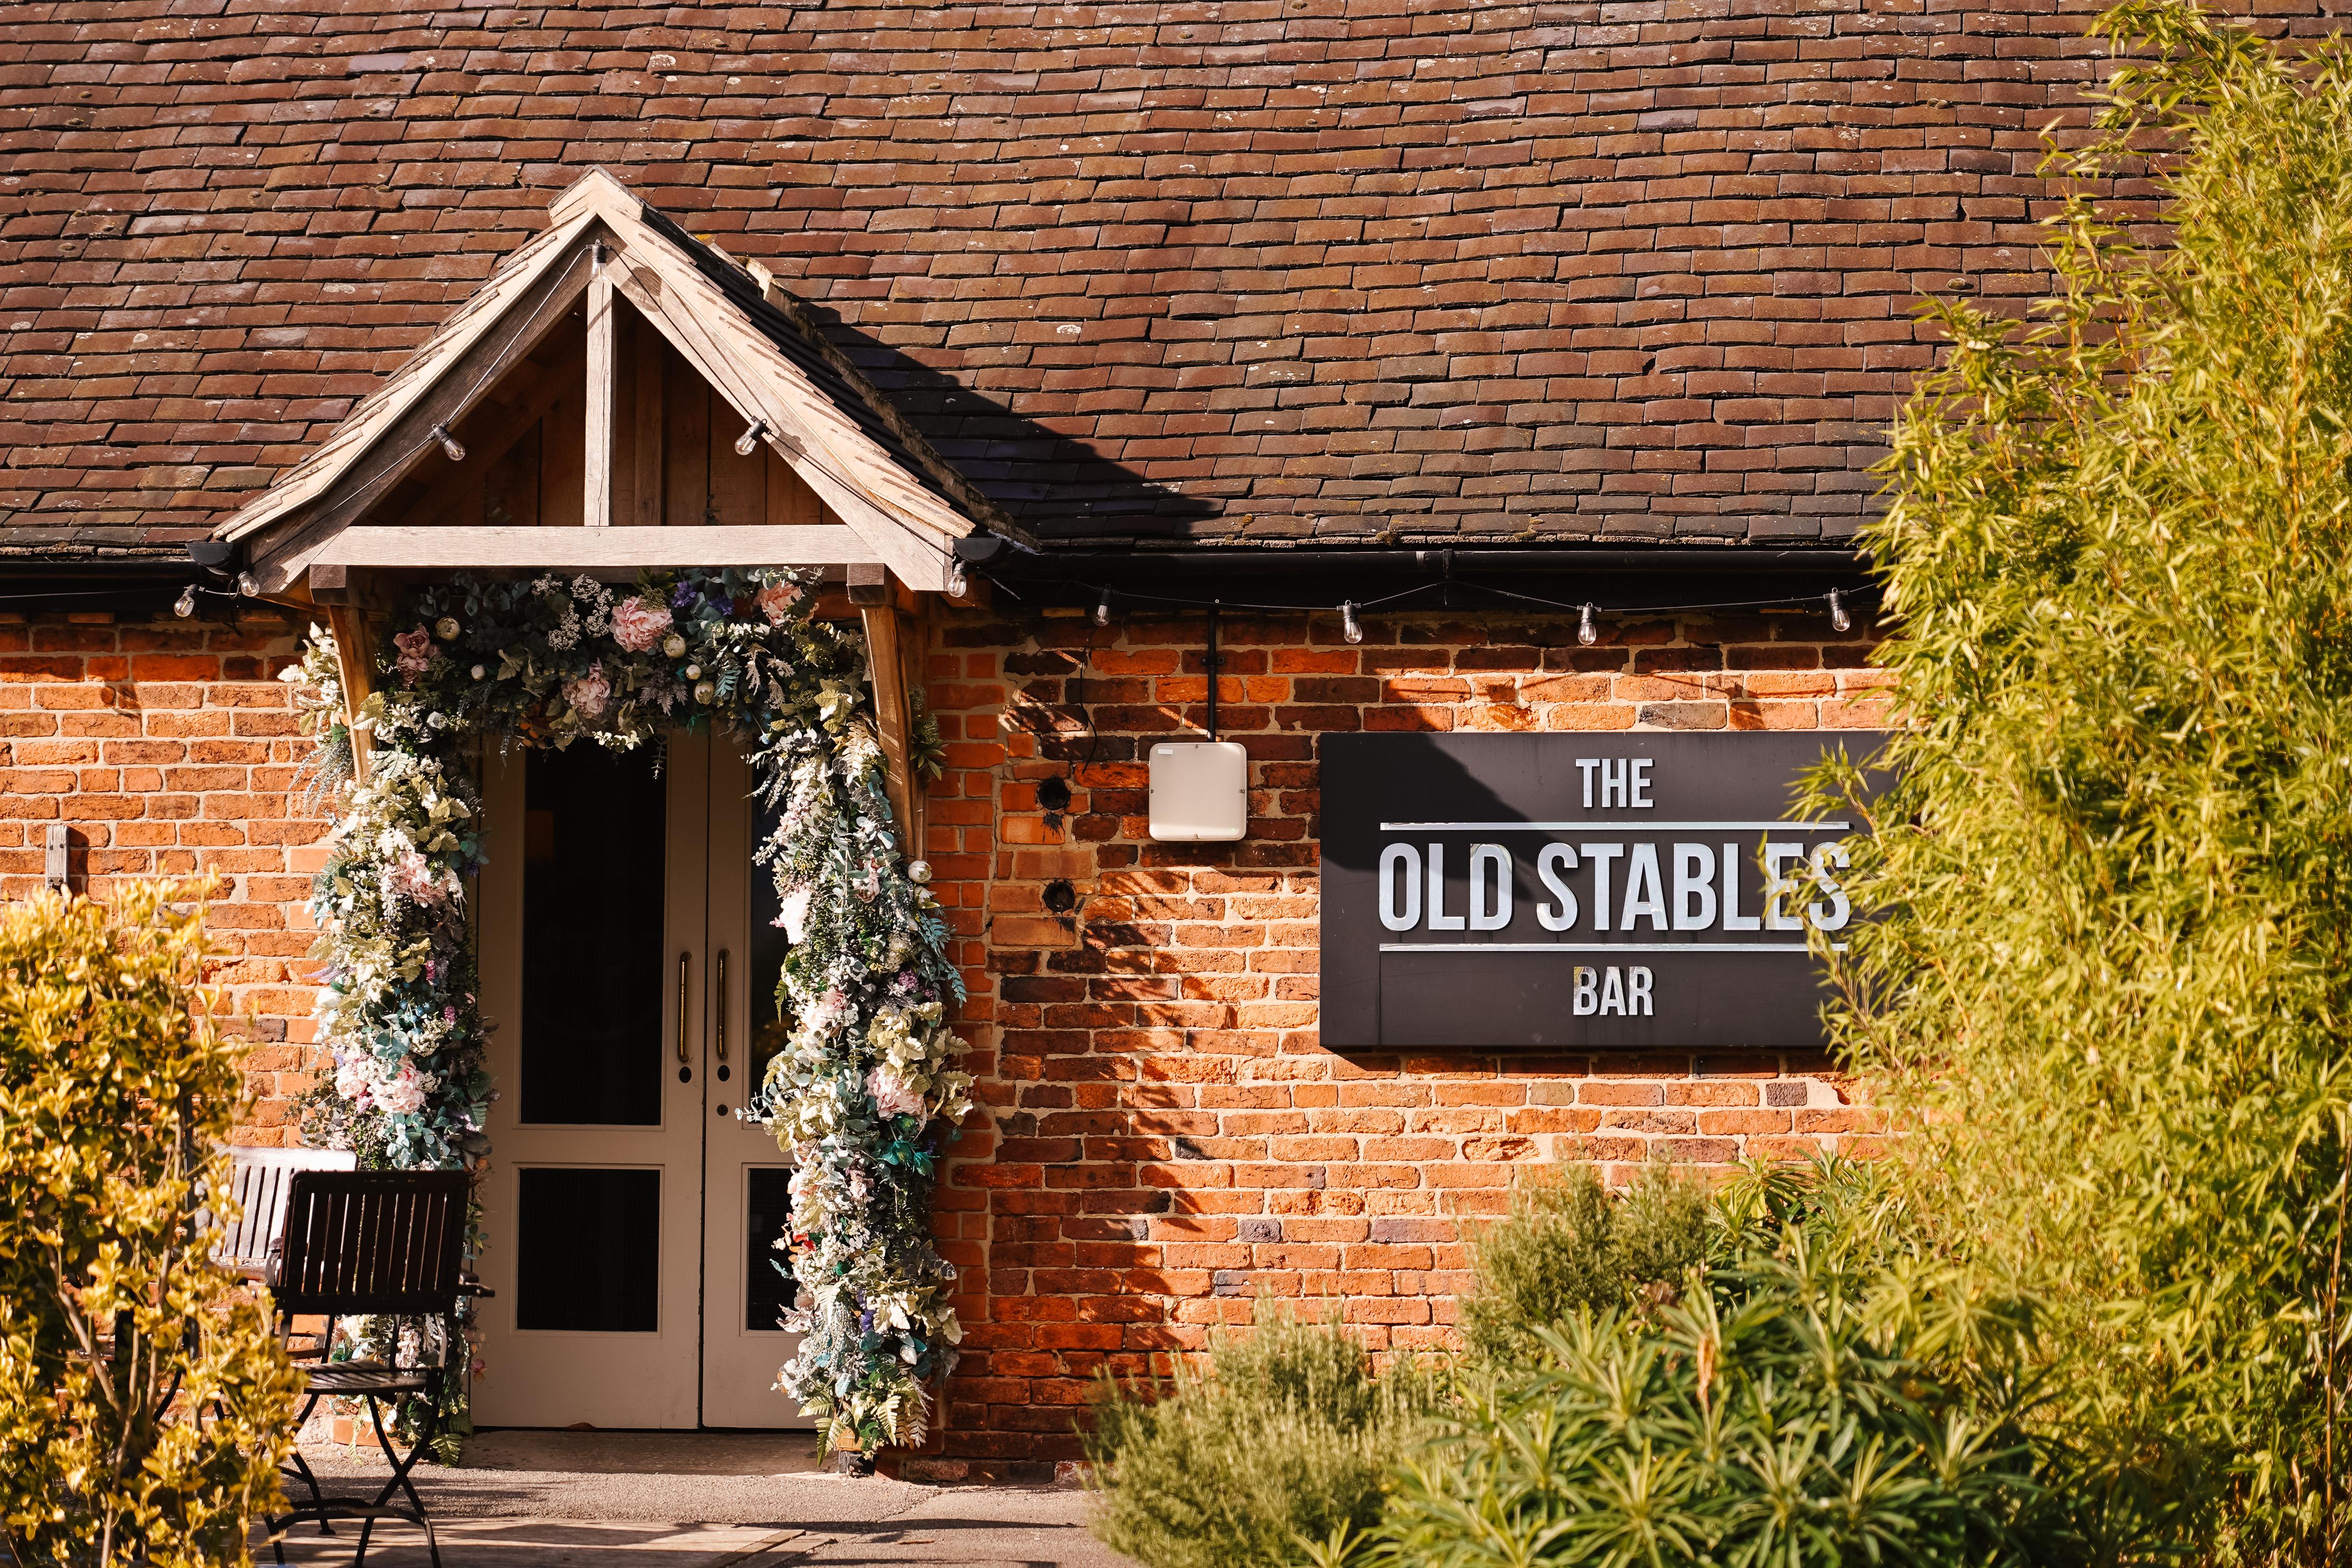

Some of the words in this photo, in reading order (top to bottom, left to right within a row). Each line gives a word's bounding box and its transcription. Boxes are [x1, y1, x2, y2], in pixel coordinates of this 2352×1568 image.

[1575, 758, 1654, 808] THE
[1378, 843, 1513, 930] OLD
[1537, 842, 1850, 931] STABLES
[1573, 966, 1654, 1016] BAR
